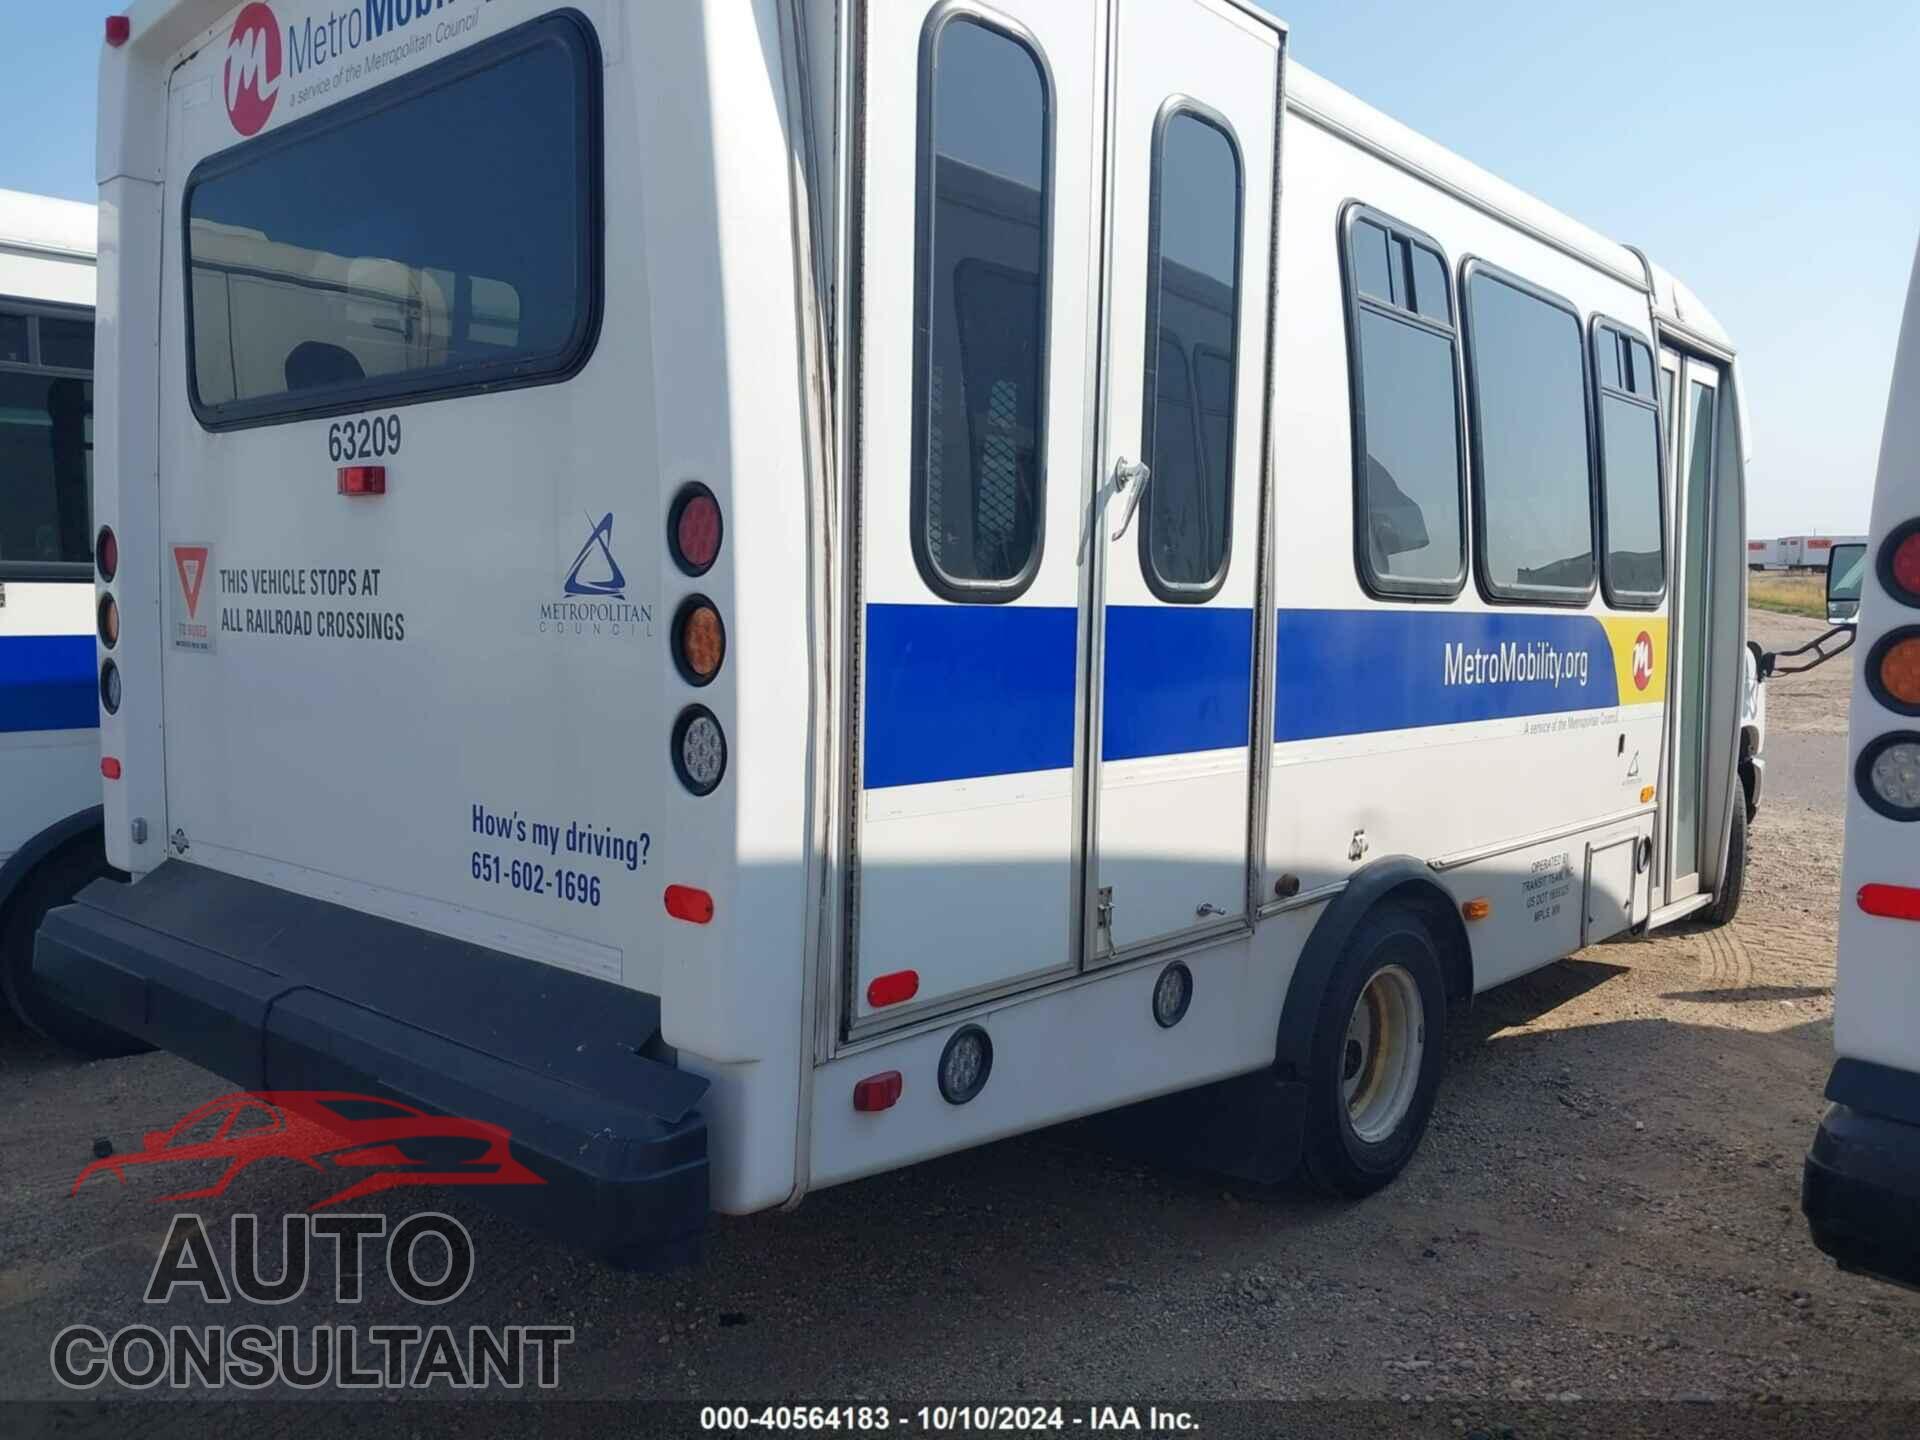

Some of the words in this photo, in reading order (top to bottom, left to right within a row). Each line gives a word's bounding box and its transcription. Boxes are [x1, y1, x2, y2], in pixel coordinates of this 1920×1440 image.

[298, 79, 330, 104] service
[332, 69, 345, 87] of
[345, 61, 361, 83] the
[364, 31, 432, 74] Metropolitan
[434, 8, 480, 45] Council
[328, 413, 401, 462] 63209
[219, 568, 249, 595] THIS
[251, 568, 306, 596] VEHICLE
[310, 568, 357, 597] STOPS
[361, 568, 381, 597] AT
[220, 607, 244, 633] ALL
[246, 608, 313, 637] RAILROAD
[316, 610, 405, 642] CROSSINGS
[539, 602, 653, 622] METROPOLITAN
[539, 621, 654, 637] COUNCIL
[1443, 641, 1589, 689] MetroMobility.org
[472, 803, 527, 842] How's
[532, 822, 560, 856] my
[566, 820, 651, 871] driving?
[471, 851, 601, 907] 651-602-1696
